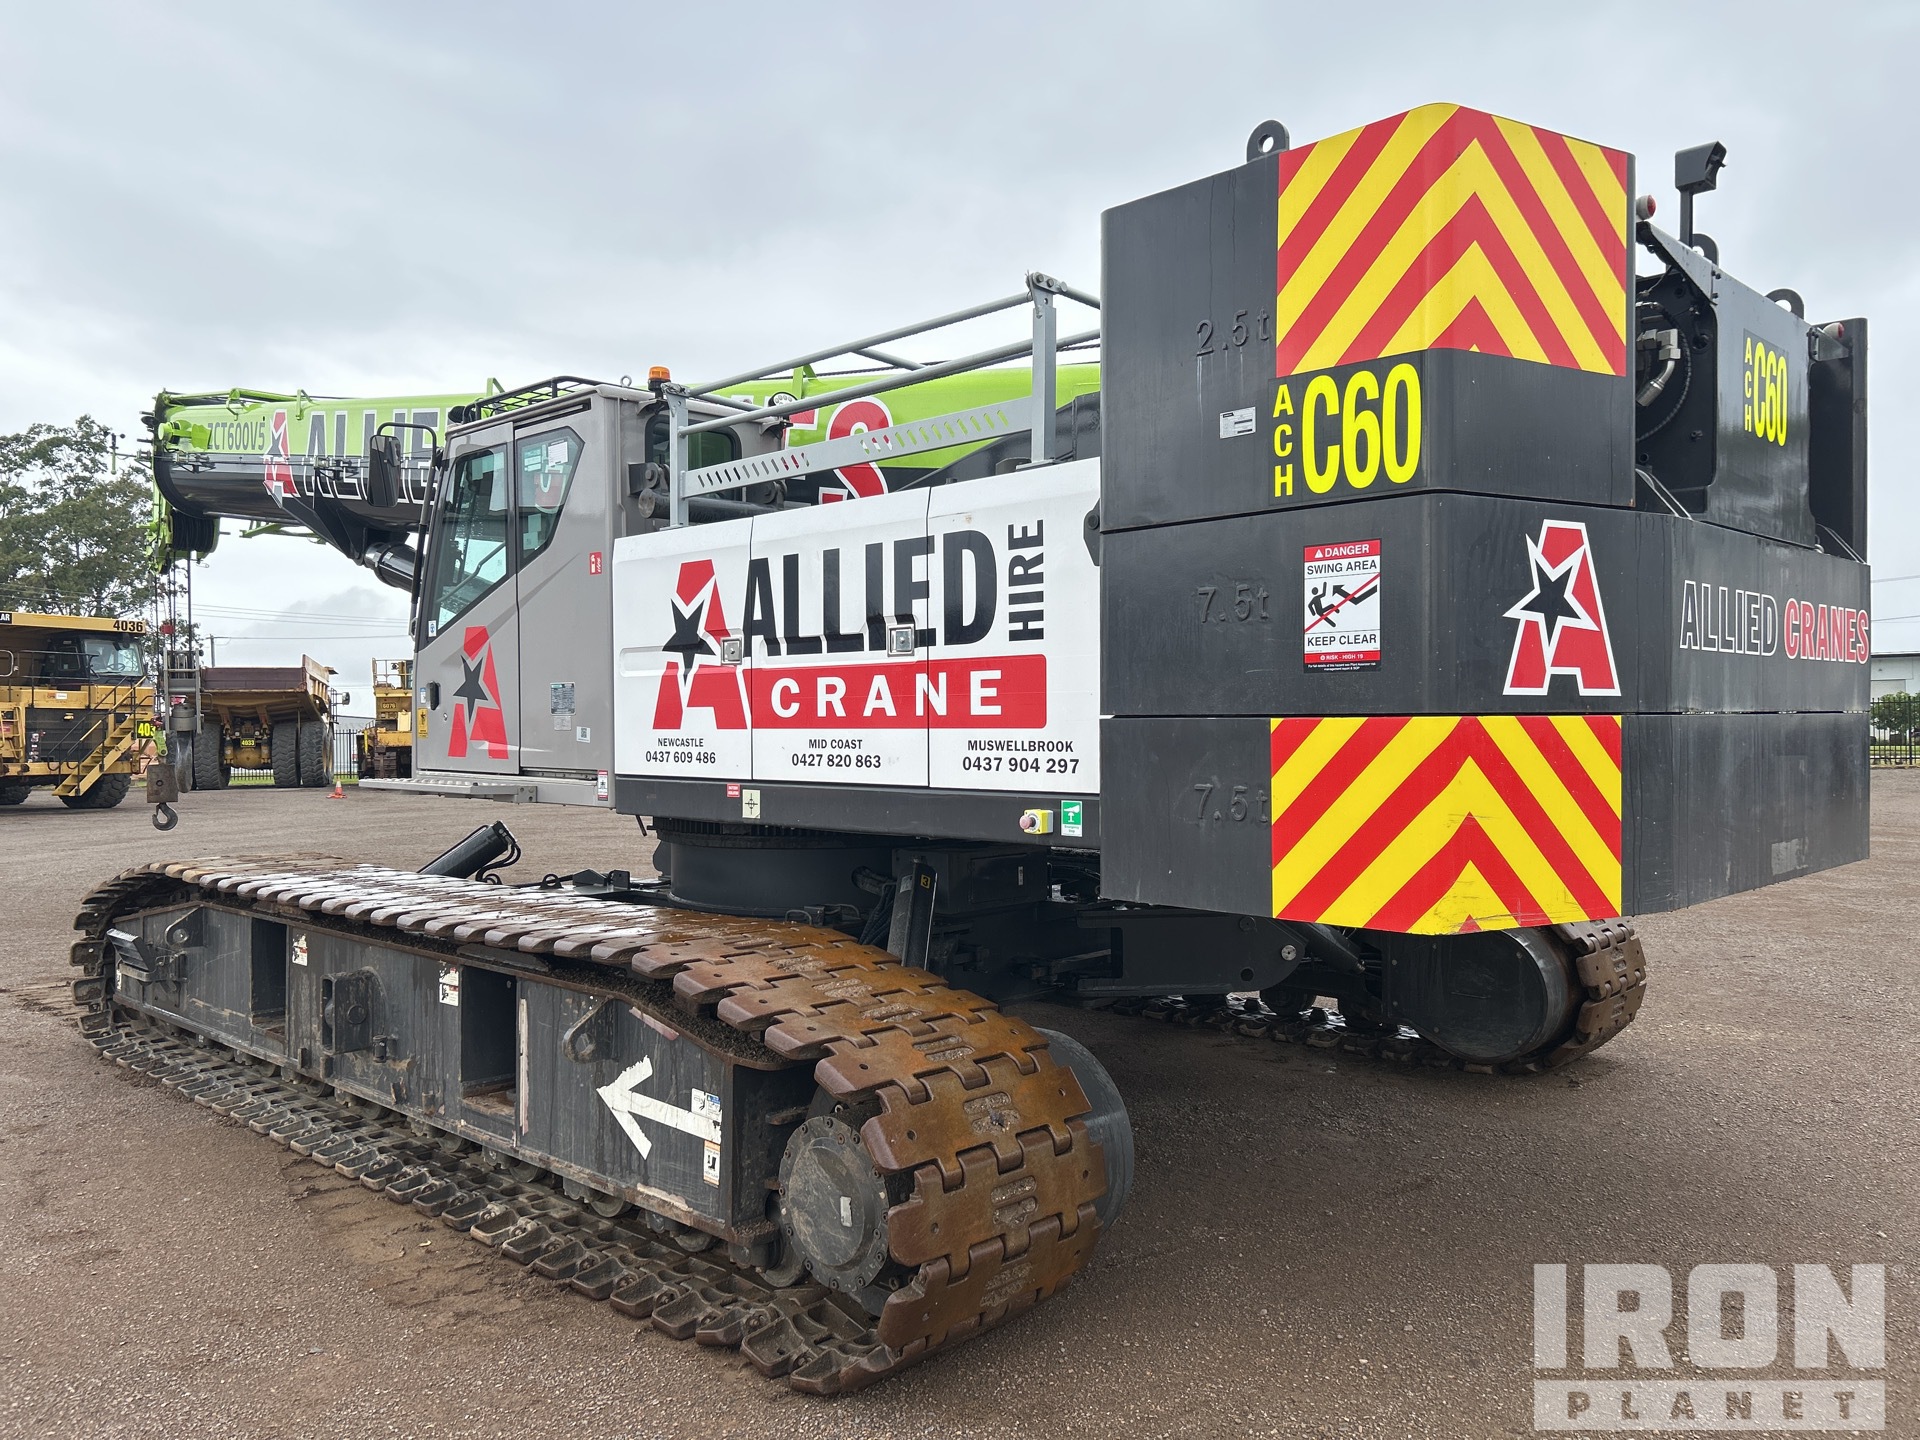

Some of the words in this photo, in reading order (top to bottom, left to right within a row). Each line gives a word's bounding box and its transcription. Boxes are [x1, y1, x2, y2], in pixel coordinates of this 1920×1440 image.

[1195, 306, 1270, 357] 2.5t
[1753, 342, 1787, 446] C60
[1302, 363, 1421, 494] C60
[1325, 544, 1369, 558] DANGER
[1307, 562, 1343, 575] SWING
[1345, 559, 1377, 572] AREA
[1008, 519, 1044, 642] HIRE
[742, 530, 997, 659] ALLIED
[1197, 584, 1270, 623] 7.5t
[113, 620, 144, 632] 4036
[1680, 580, 1778, 656] ALLIED
[1784, 597, 1869, 664] CRANES
[1307, 635, 1336, 647] KEEP
[1338, 633, 1377, 645] CLEAR
[771, 669, 1002, 718] CRANE
[138, 723, 156, 737] 403
[657, 738, 704, 748] NEWCASTLE
[808, 739, 828, 749] MID
[830, 739, 863, 750] COAST
[967, 740, 1074, 752] MUSWELLBROOK
[645, 751, 670, 763] 0437
[674, 751, 693, 763] 609
[696, 751, 716, 764] 486
[791, 753, 824, 766] 0427
[827, 754, 851, 768] 820
[855, 754, 881, 768] 863
[962, 756, 1002, 771] 0437
[1008, 757, 1041, 773] 904
[1046, 758, 1080, 774] 297
[1194, 783, 1269, 823] 7.5t
